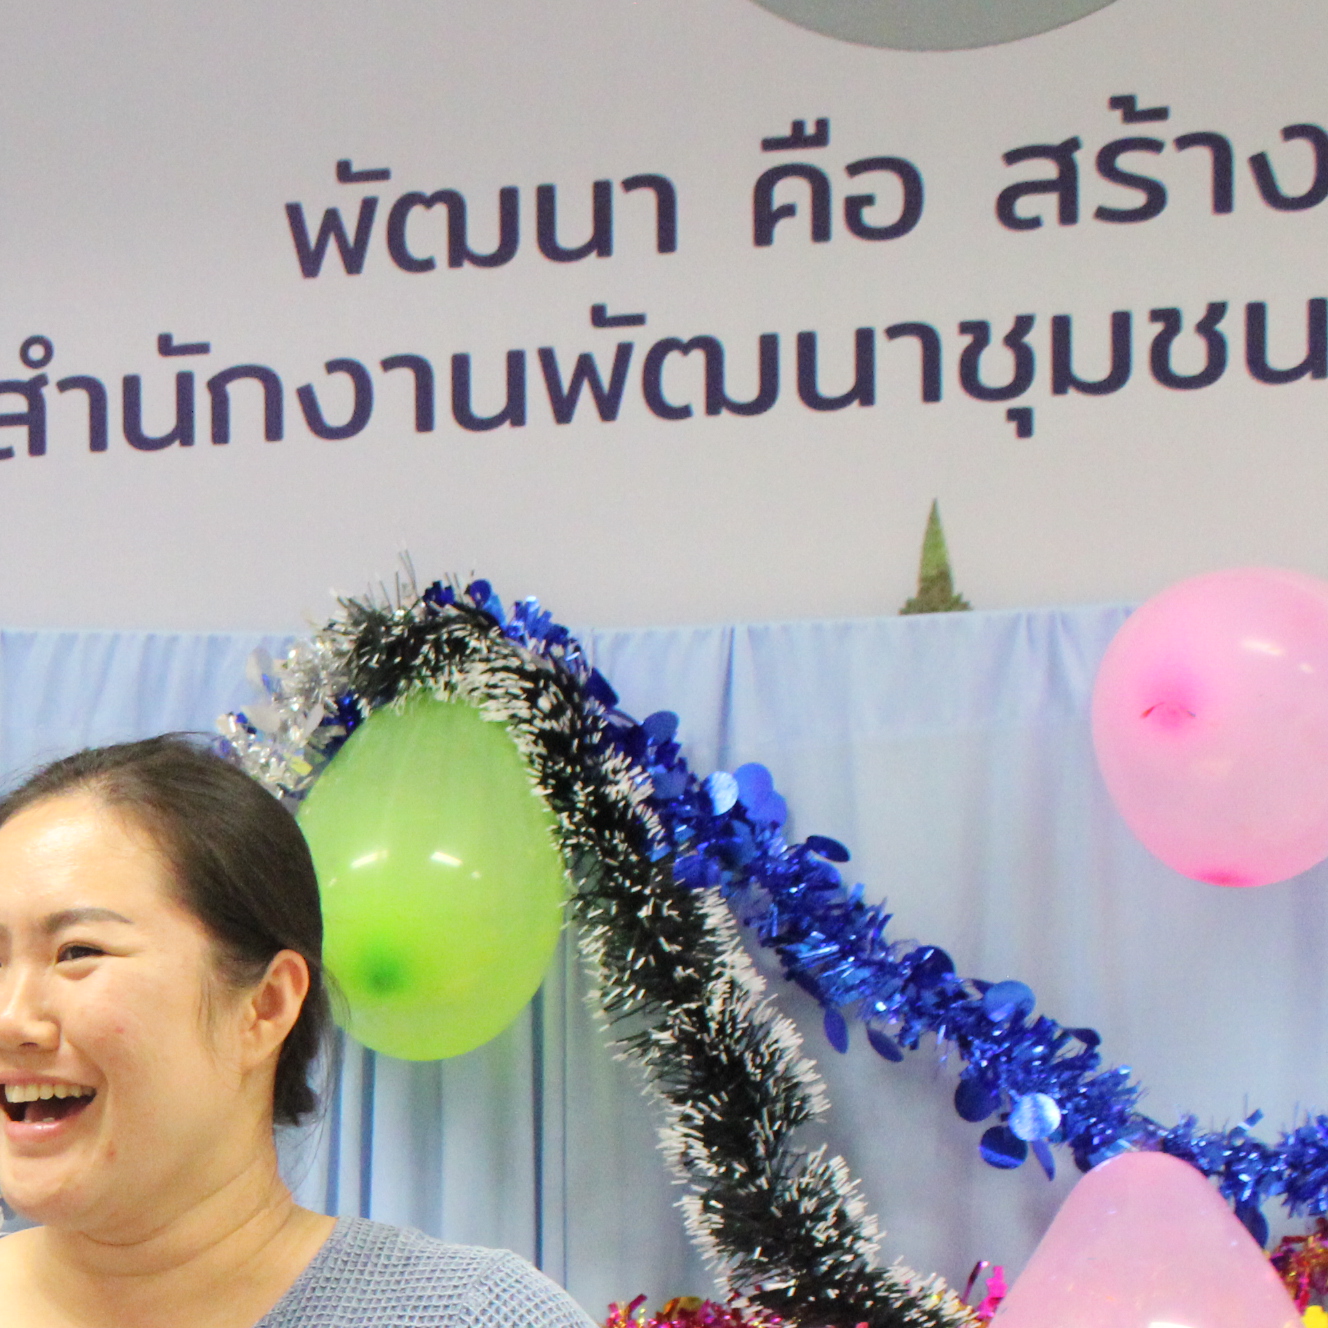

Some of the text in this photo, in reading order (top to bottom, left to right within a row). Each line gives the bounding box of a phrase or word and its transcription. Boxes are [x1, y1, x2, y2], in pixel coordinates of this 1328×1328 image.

[286, 94, 1328, 279] พัฒนา คือ สร้าง
